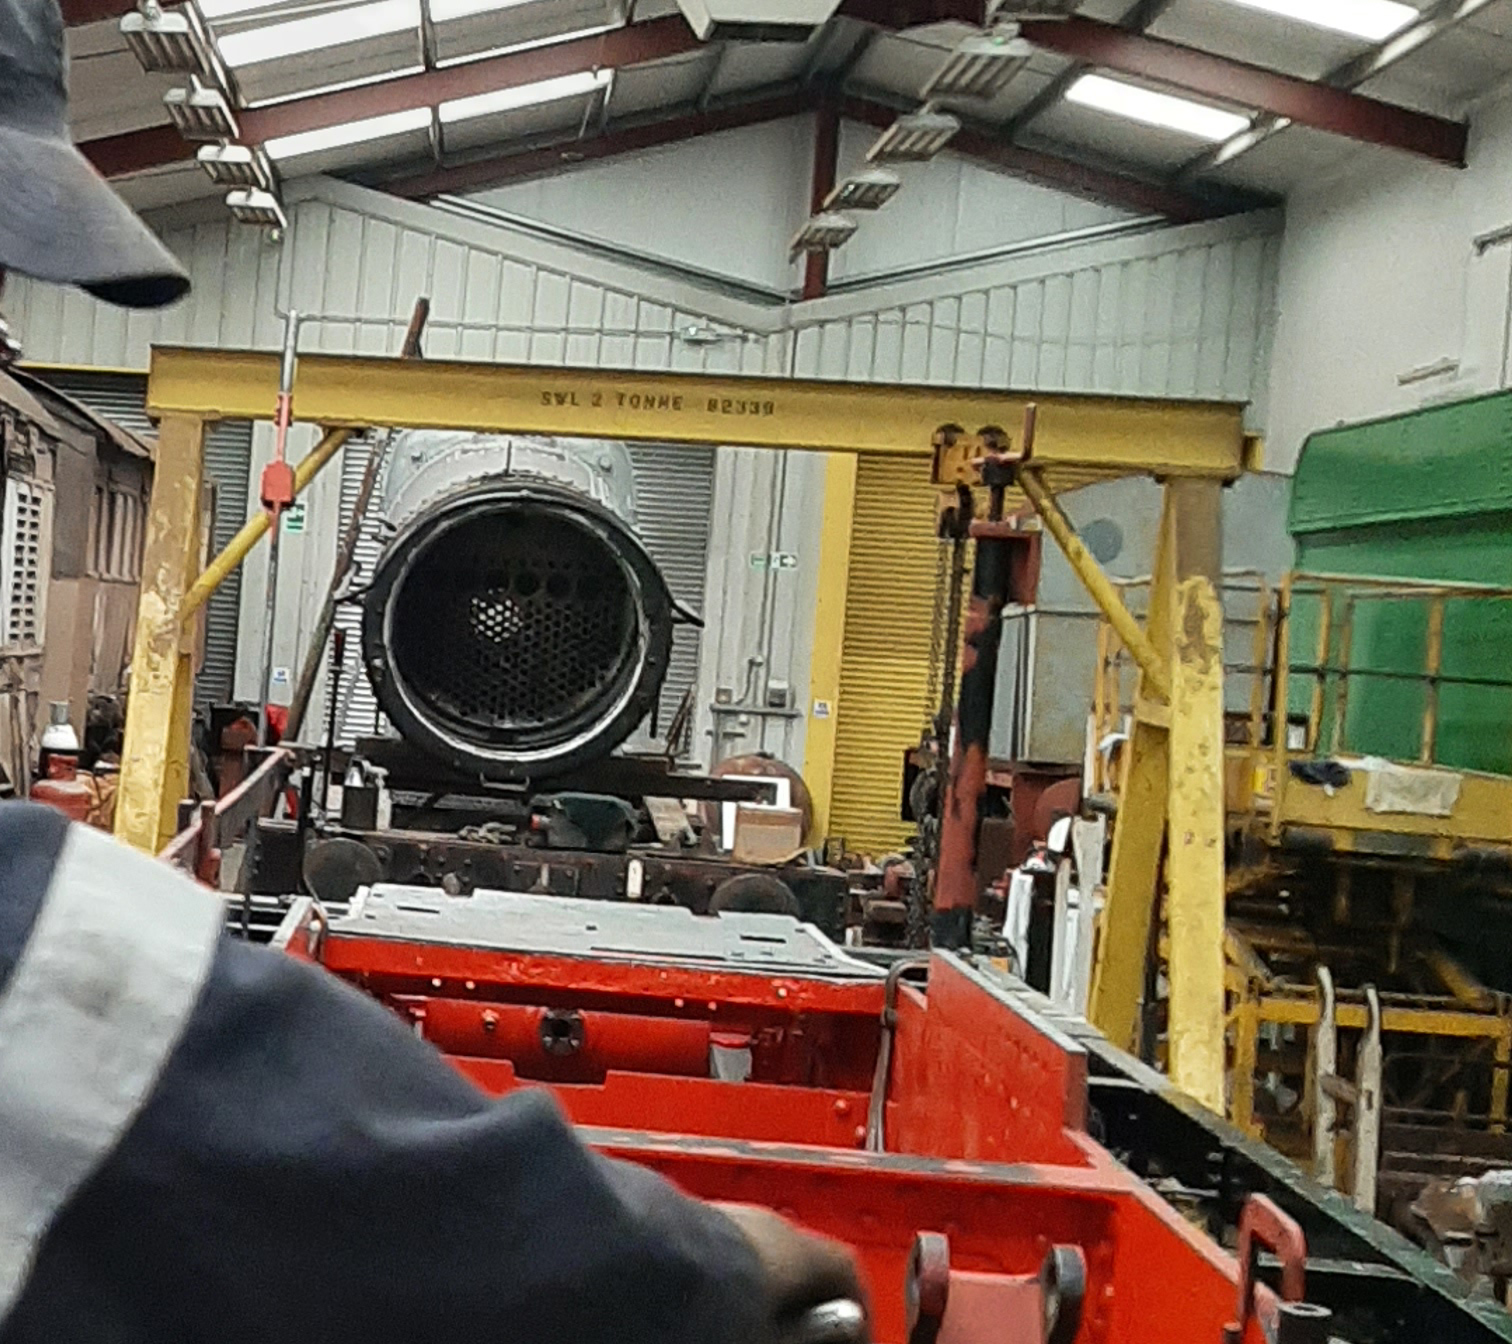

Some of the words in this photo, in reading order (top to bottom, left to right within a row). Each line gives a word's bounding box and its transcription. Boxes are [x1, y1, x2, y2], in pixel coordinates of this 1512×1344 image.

[540, 391, 579, 407] SWL
[591, 392, 603, 408] 2
[616, 392, 683, 411] TONNE
